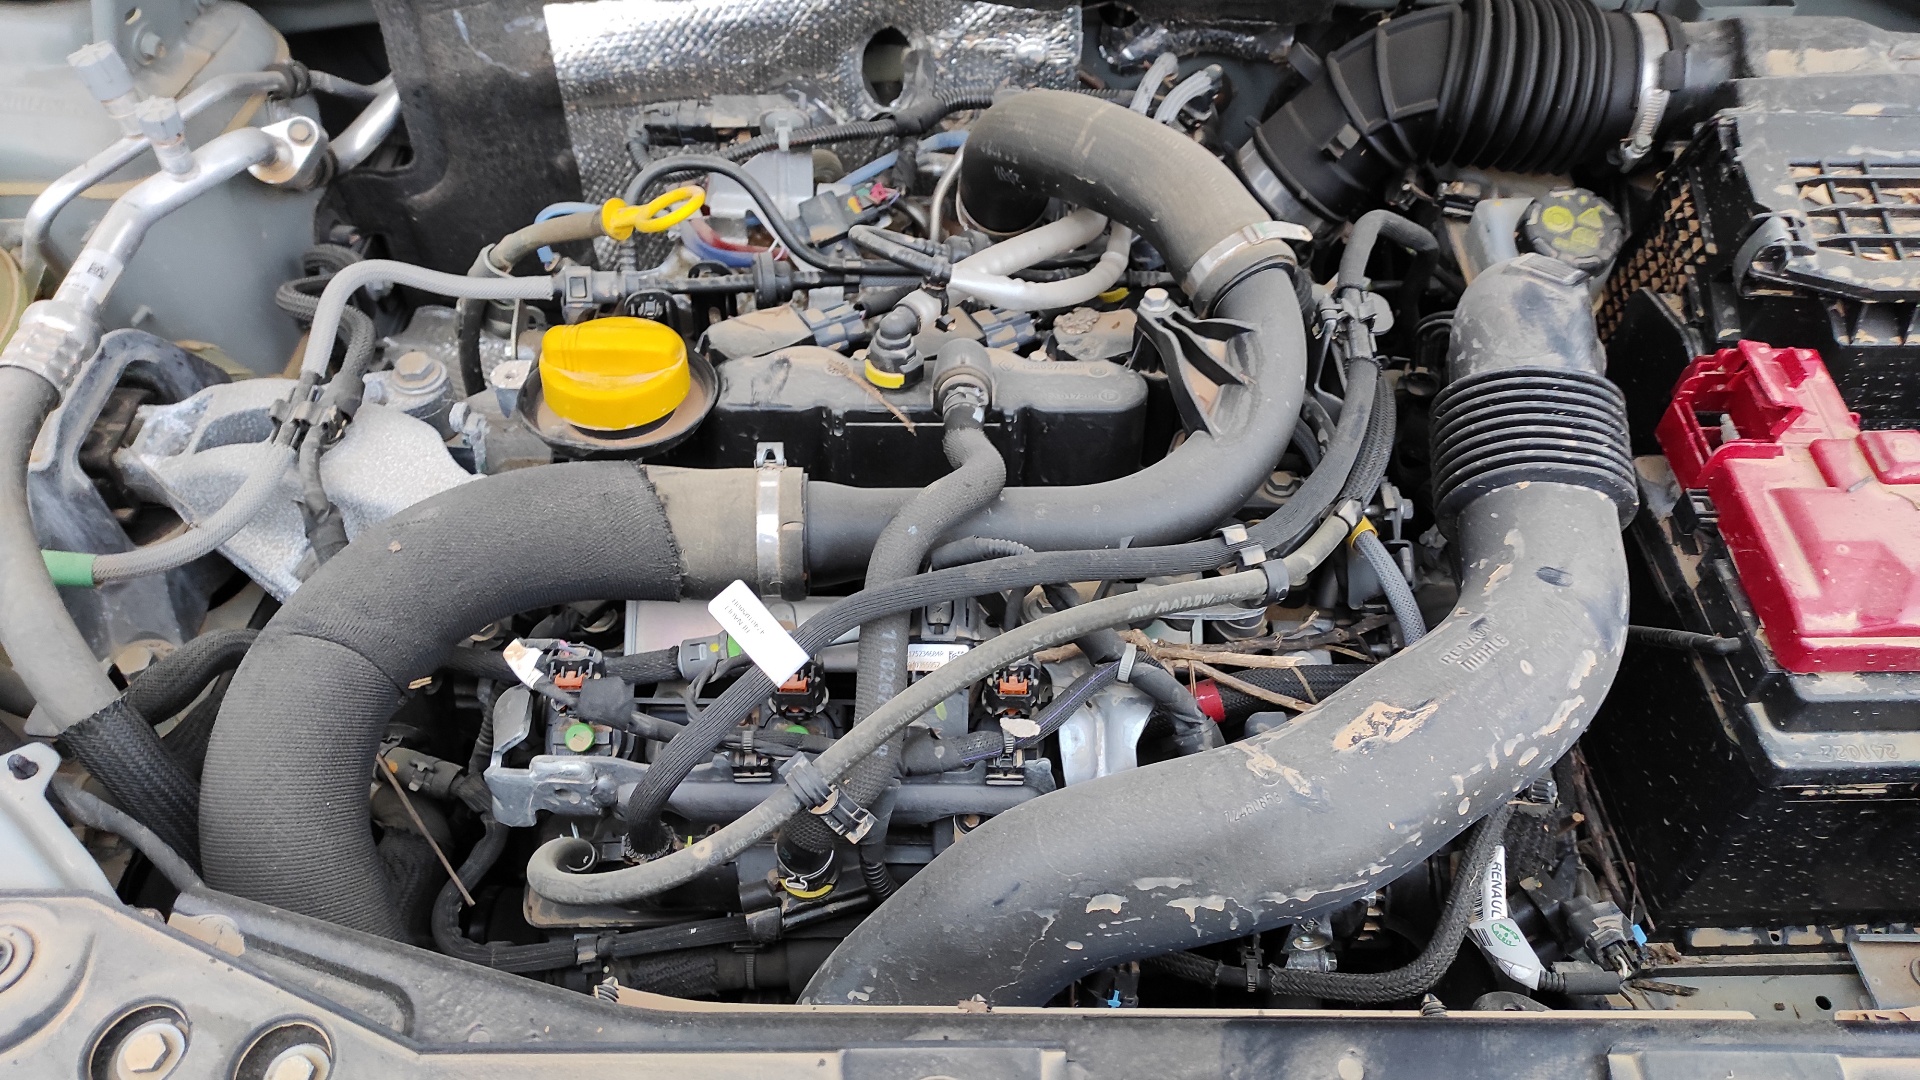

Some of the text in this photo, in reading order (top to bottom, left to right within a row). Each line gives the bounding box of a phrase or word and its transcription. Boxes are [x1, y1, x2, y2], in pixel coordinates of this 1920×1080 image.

[1459, 631, 1510, 673] MAHLE
[1818, 743, 1899, 759] 241022
[1490, 861, 1504, 919] RENAUL
